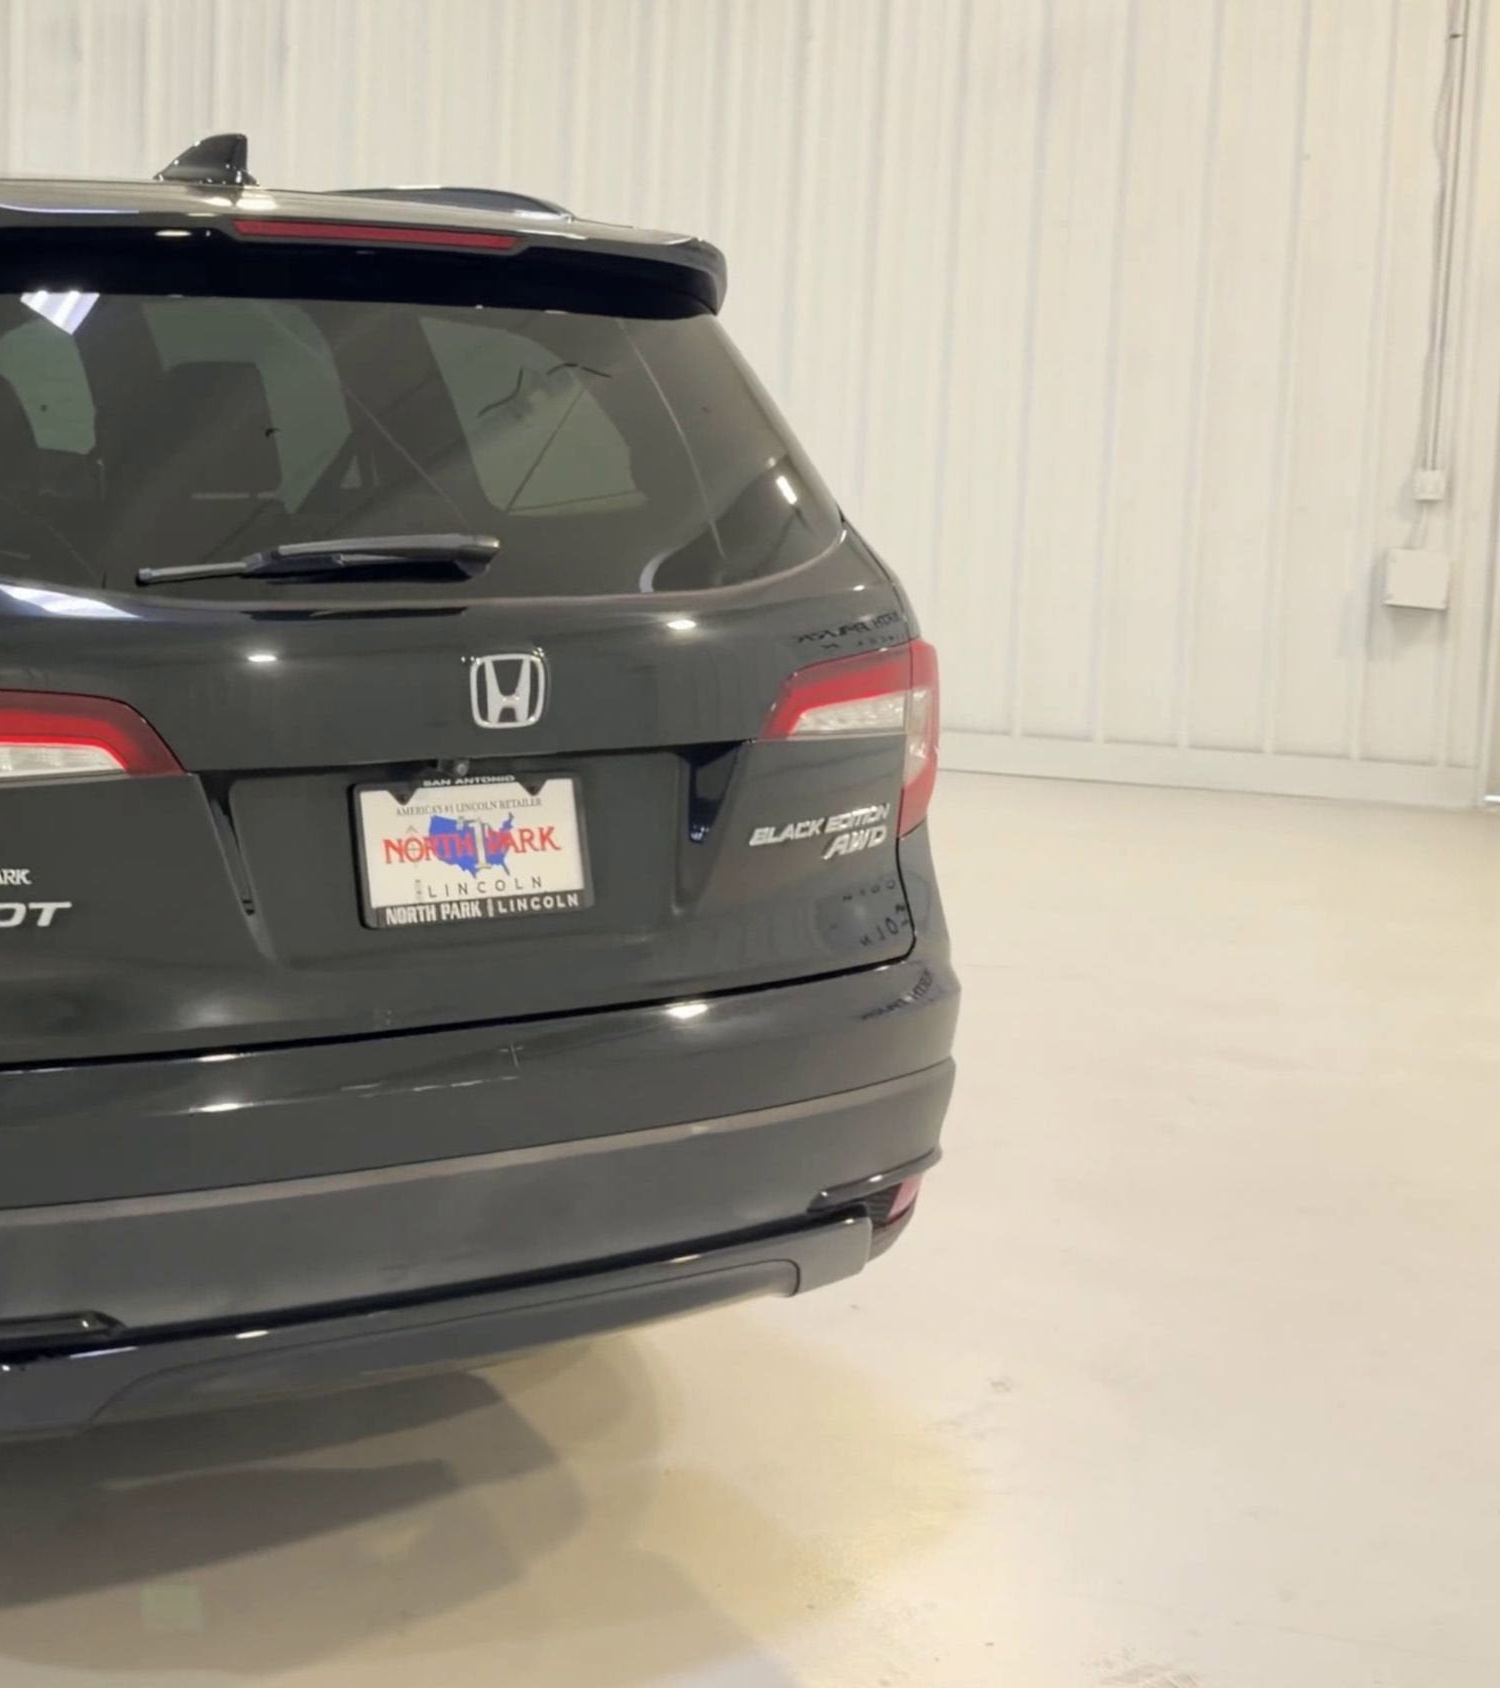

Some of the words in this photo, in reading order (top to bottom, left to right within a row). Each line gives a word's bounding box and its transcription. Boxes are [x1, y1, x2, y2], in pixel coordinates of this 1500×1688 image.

[423, 779, 451, 787] SAN
[455, 774, 516, 786] ANTONIO
[455, 800, 498, 813] LINCOLN
[499, 797, 542, 810] RETAILER
[749, 817, 825, 847] BLACK
[824, 802, 891, 834] EDITION
[382, 831, 476, 865] NORTH
[486, 825, 561, 855] PARK
[822, 825, 888, 861] AWD
[428, 876, 543, 898] LINCOLN
[385, 904, 437, 926] NORTH
[441, 899, 483, 922] PARK
[498, 893, 580, 914] LINCOLN
